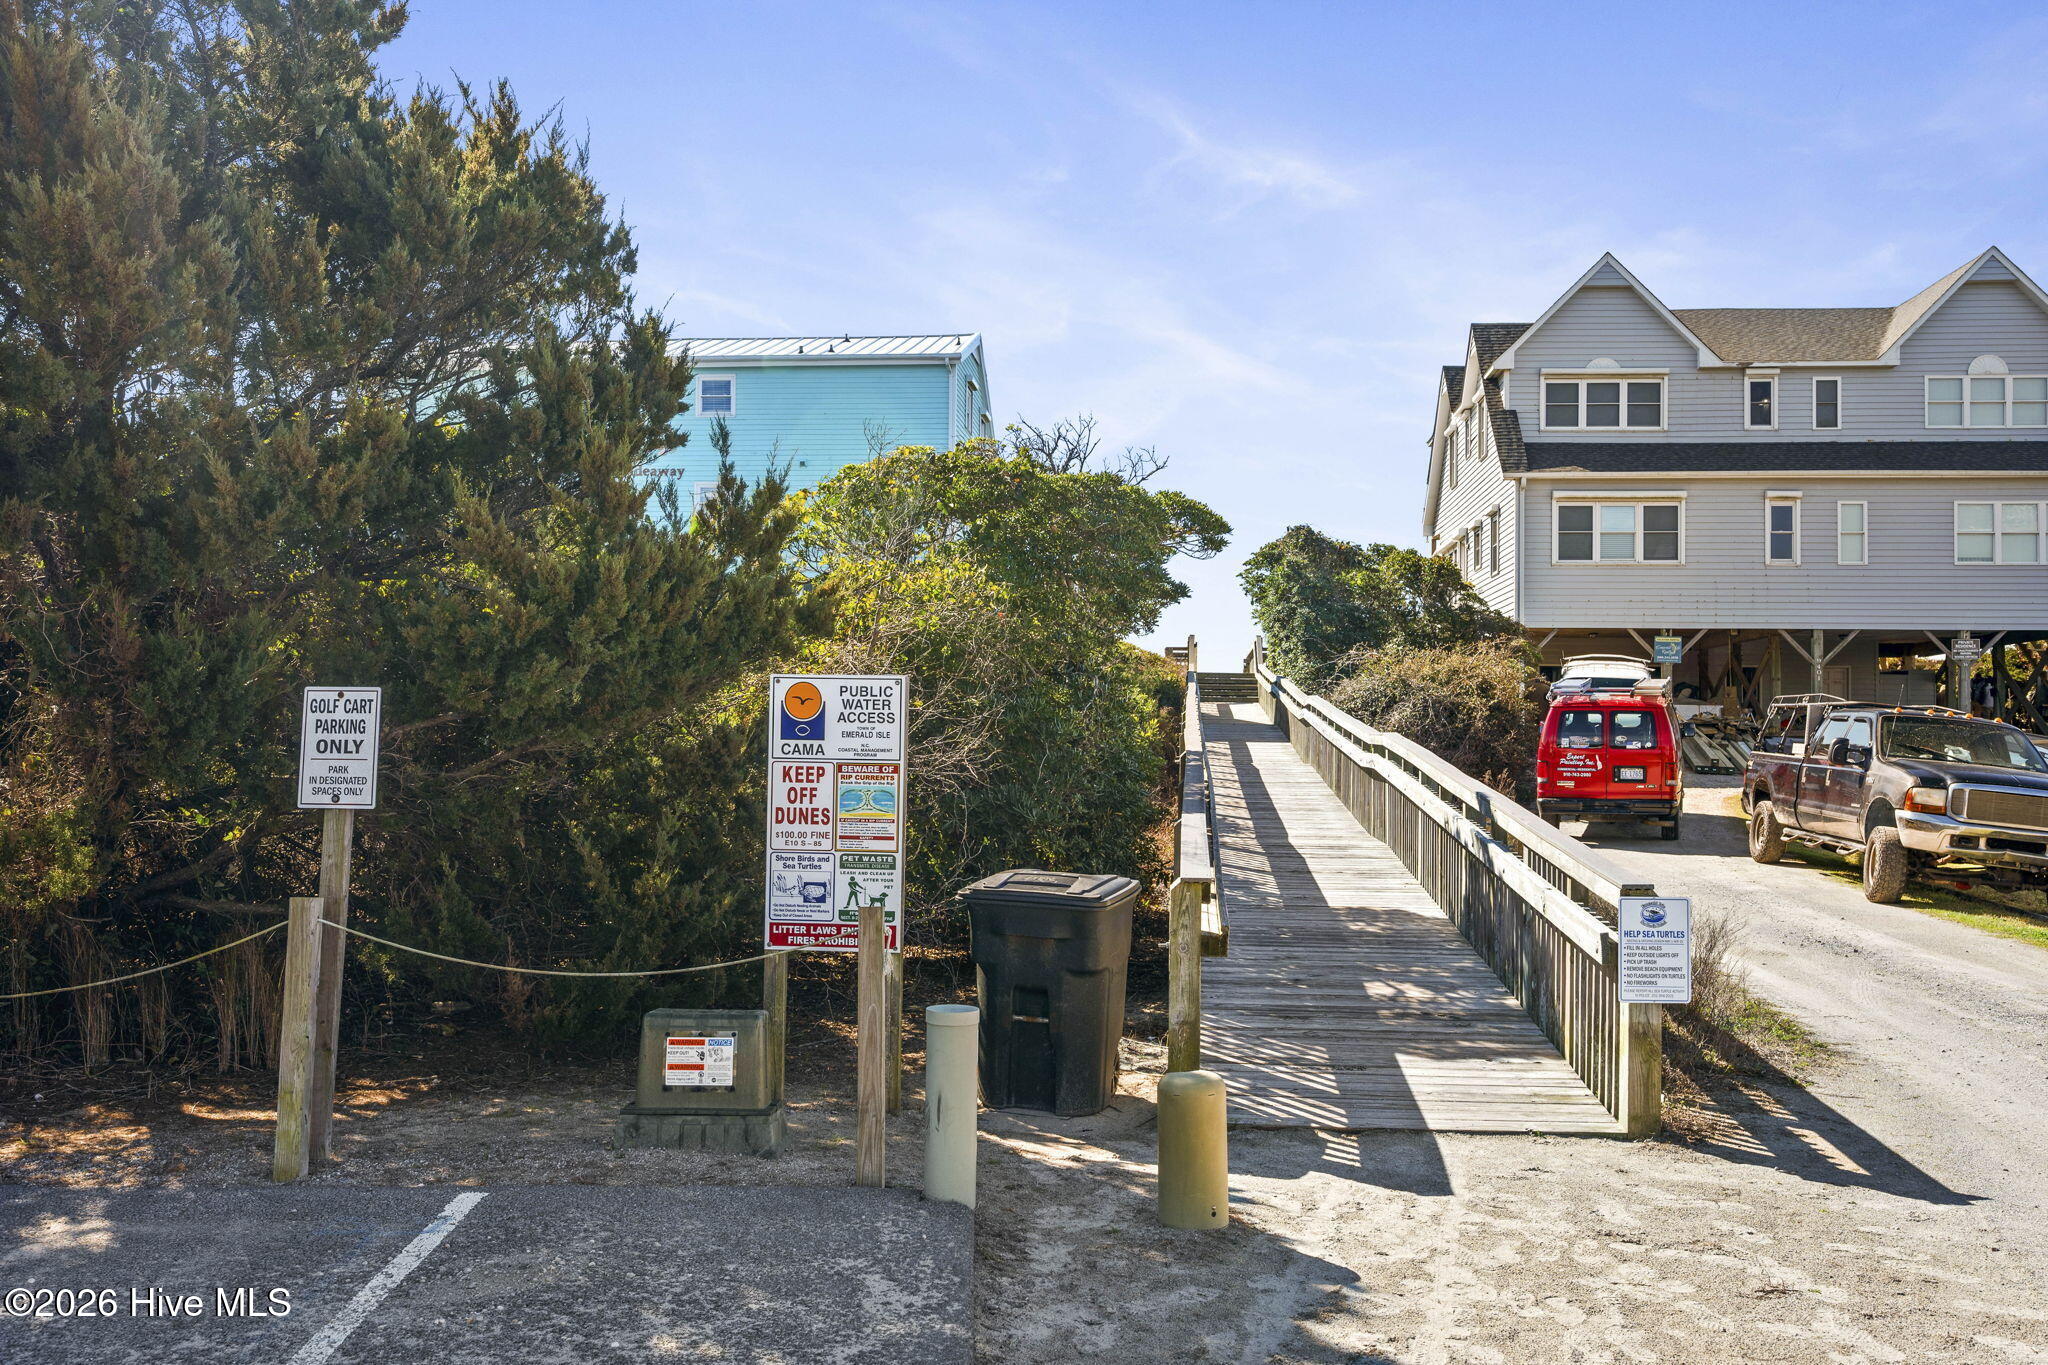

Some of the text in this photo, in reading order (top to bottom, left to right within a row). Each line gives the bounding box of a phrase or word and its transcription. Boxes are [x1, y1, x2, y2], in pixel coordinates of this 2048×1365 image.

[840, 686, 894, 698] PUBLIC
[310, 698, 373, 713] GOLF CART
[842, 699, 892, 710] WATER
[837, 712, 895, 724] ACCESS
[315, 719, 366, 734] PARKING
[316, 739, 364, 754] ONLY
[781, 743, 825, 756] CAMA
[782, 766, 825, 783] KEEP
[319, 777, 367, 785] DESIGNATED
[312, 787, 364, 796] SPACES ONLY
[787, 786, 817, 804] OFF
[775, 807, 830, 825] DUNES
[773, 925, 806, 933] LITTER
[810, 926, 837, 935] LAWS
[788, 936, 858, 946] FIRES PROHIBI
